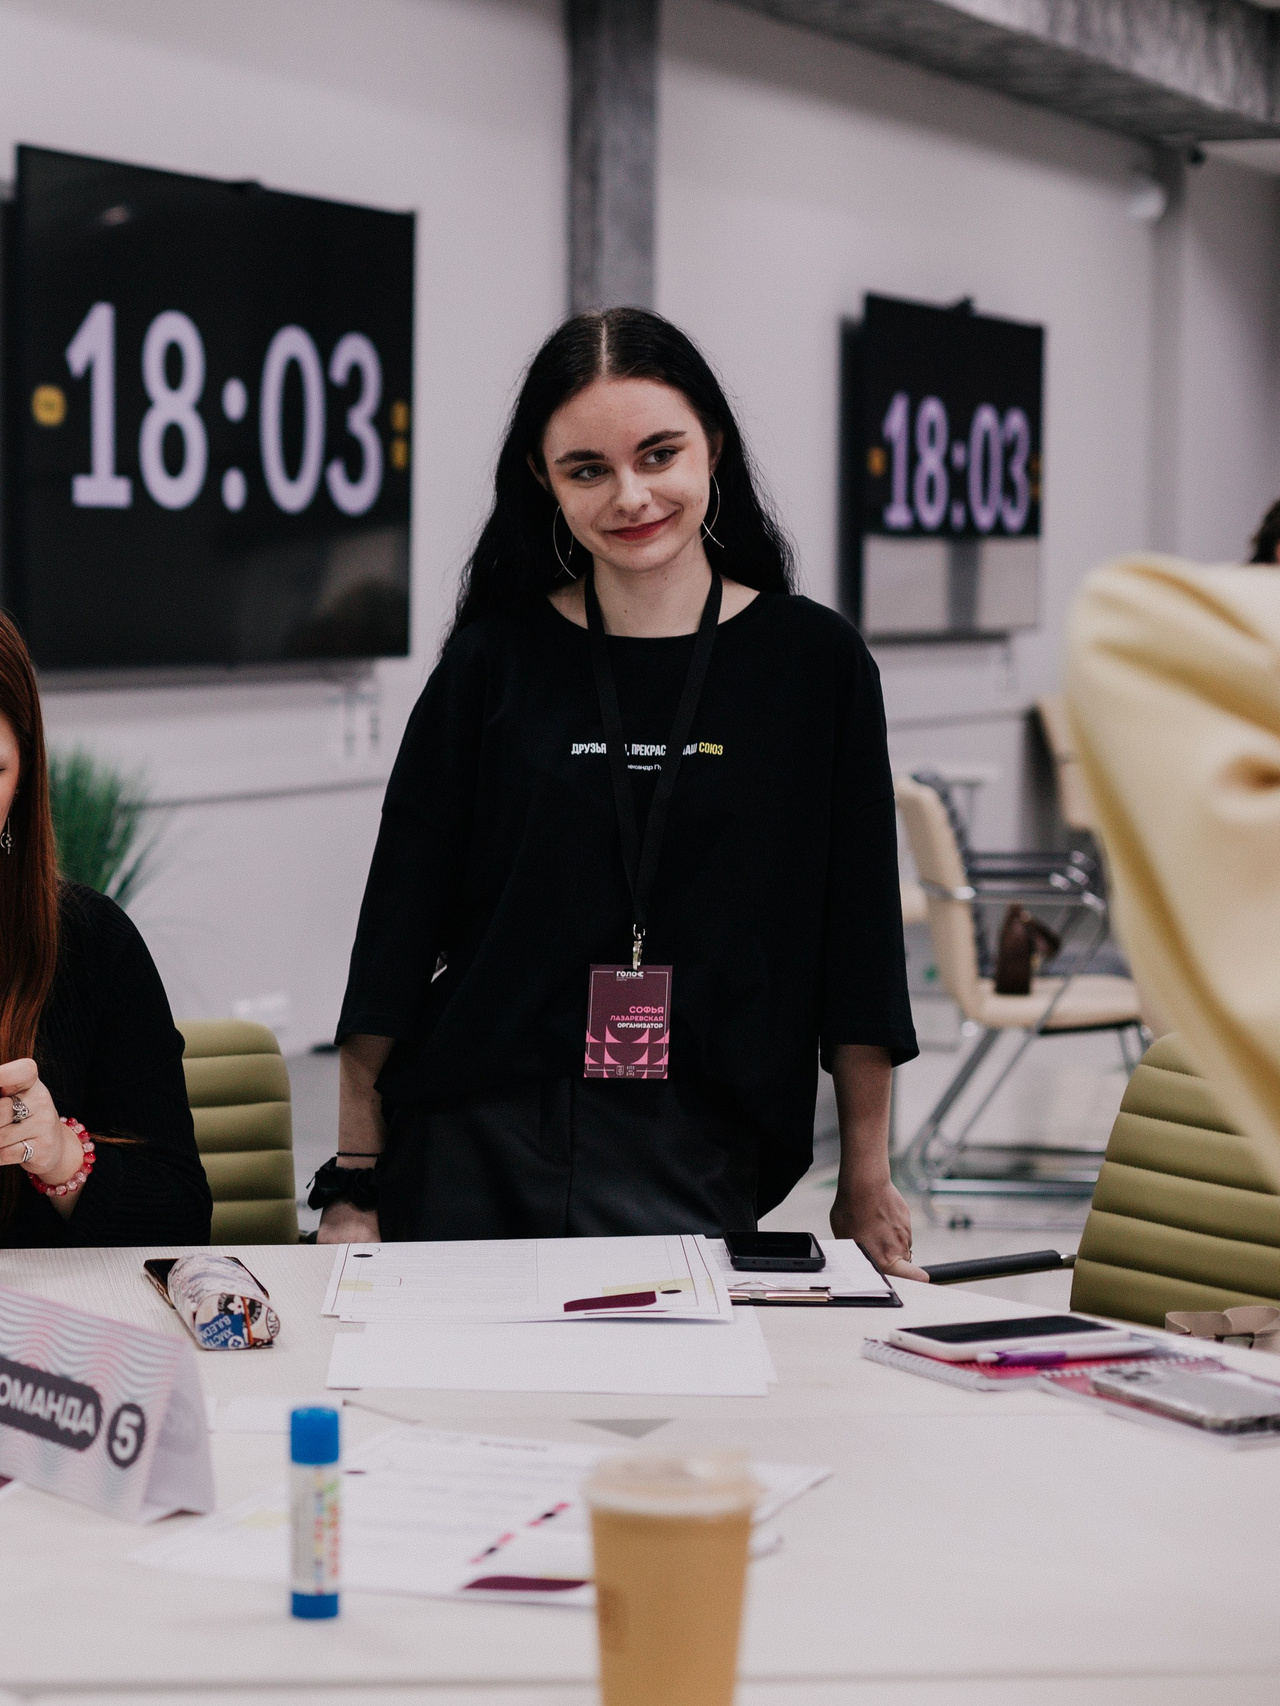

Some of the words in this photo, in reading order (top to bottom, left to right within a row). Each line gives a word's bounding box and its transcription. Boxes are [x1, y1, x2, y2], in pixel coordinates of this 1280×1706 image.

[65, 301, 384, 517] 18:03
[882, 391, 1030, 533] 18:03
[571, 742, 607, 755] ДРУЗЬЯ
[631, 743, 667, 756] ПРЕКРАС
[698, 742, 724, 756] СОЮЗ
[629, 1006, 664, 1014] СОФЬЯ
[111, 1410, 142, 1461] 5
